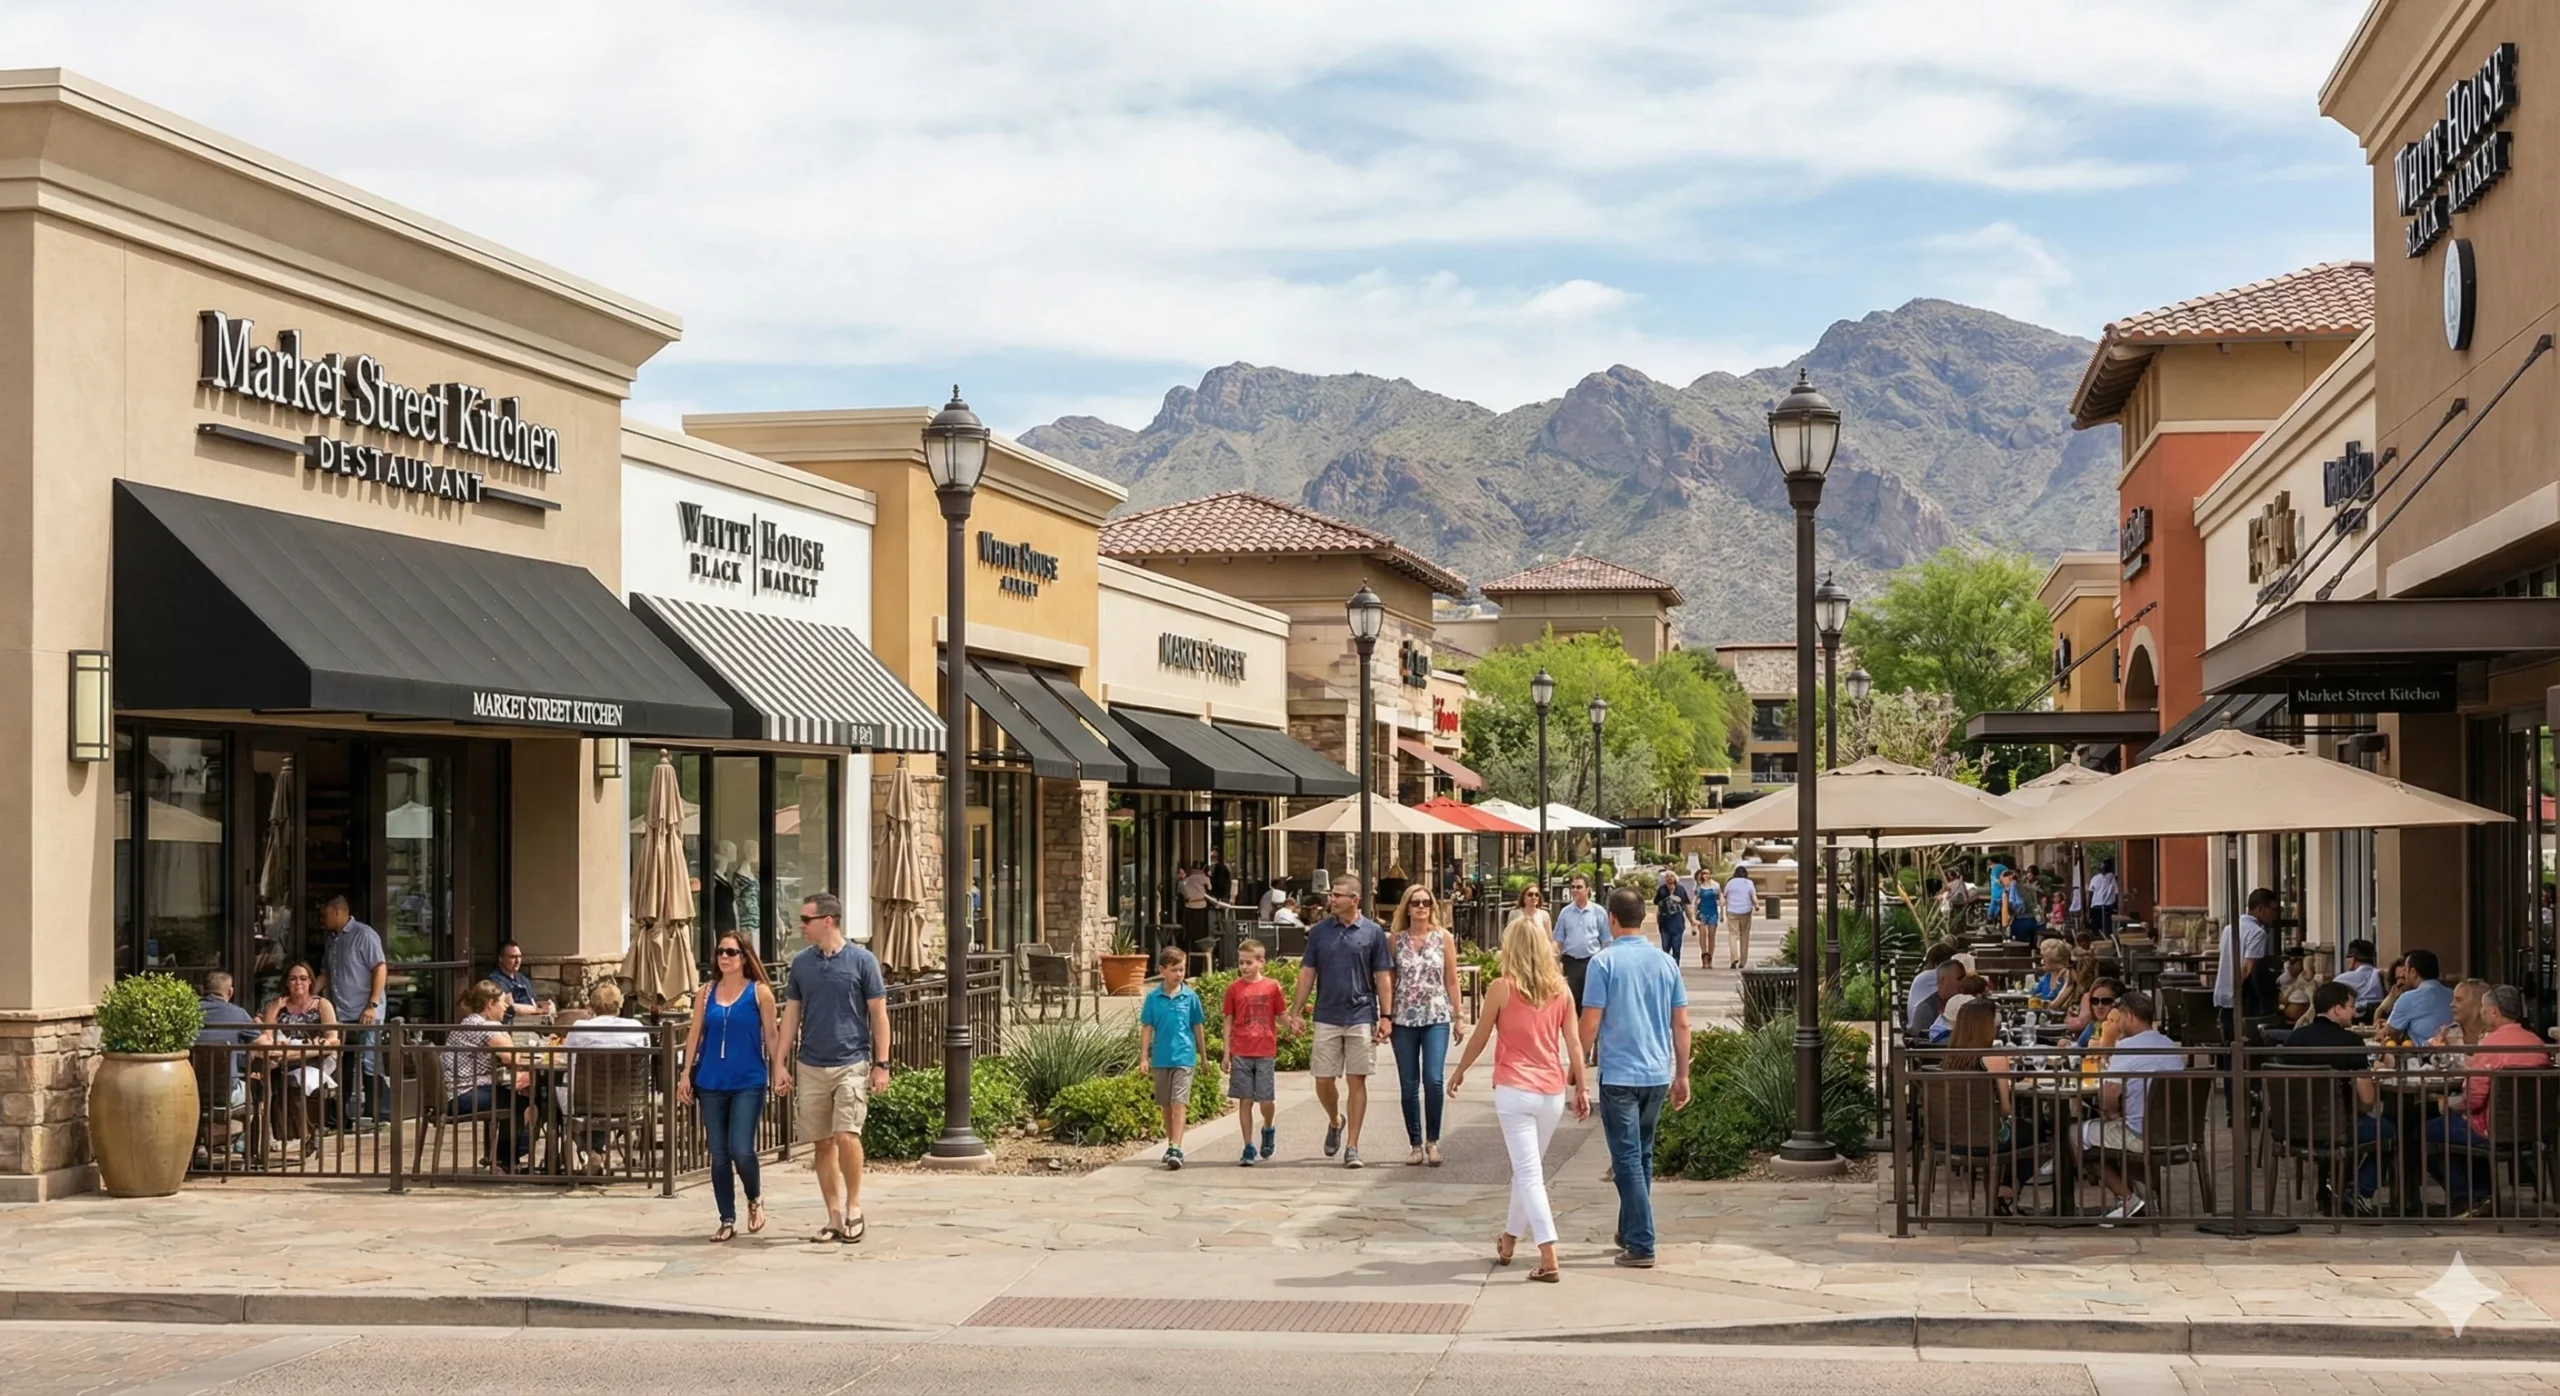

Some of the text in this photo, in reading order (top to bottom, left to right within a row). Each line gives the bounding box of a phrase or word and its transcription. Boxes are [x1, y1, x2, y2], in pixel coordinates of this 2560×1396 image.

[2394, 43, 2512, 217] WHITE HOUSE
[2405, 131, 2507, 259] BLACK MARKET
[200, 311, 562, 474] Market Street Kitchen
[677, 500, 825, 581] WHITE HOUSE
[690, 552, 819, 598] BLACK MARKET
[473, 692, 623, 726] MARKET STREET KITCHEN
[2297, 687, 2441, 703] Market Street Kitchen
